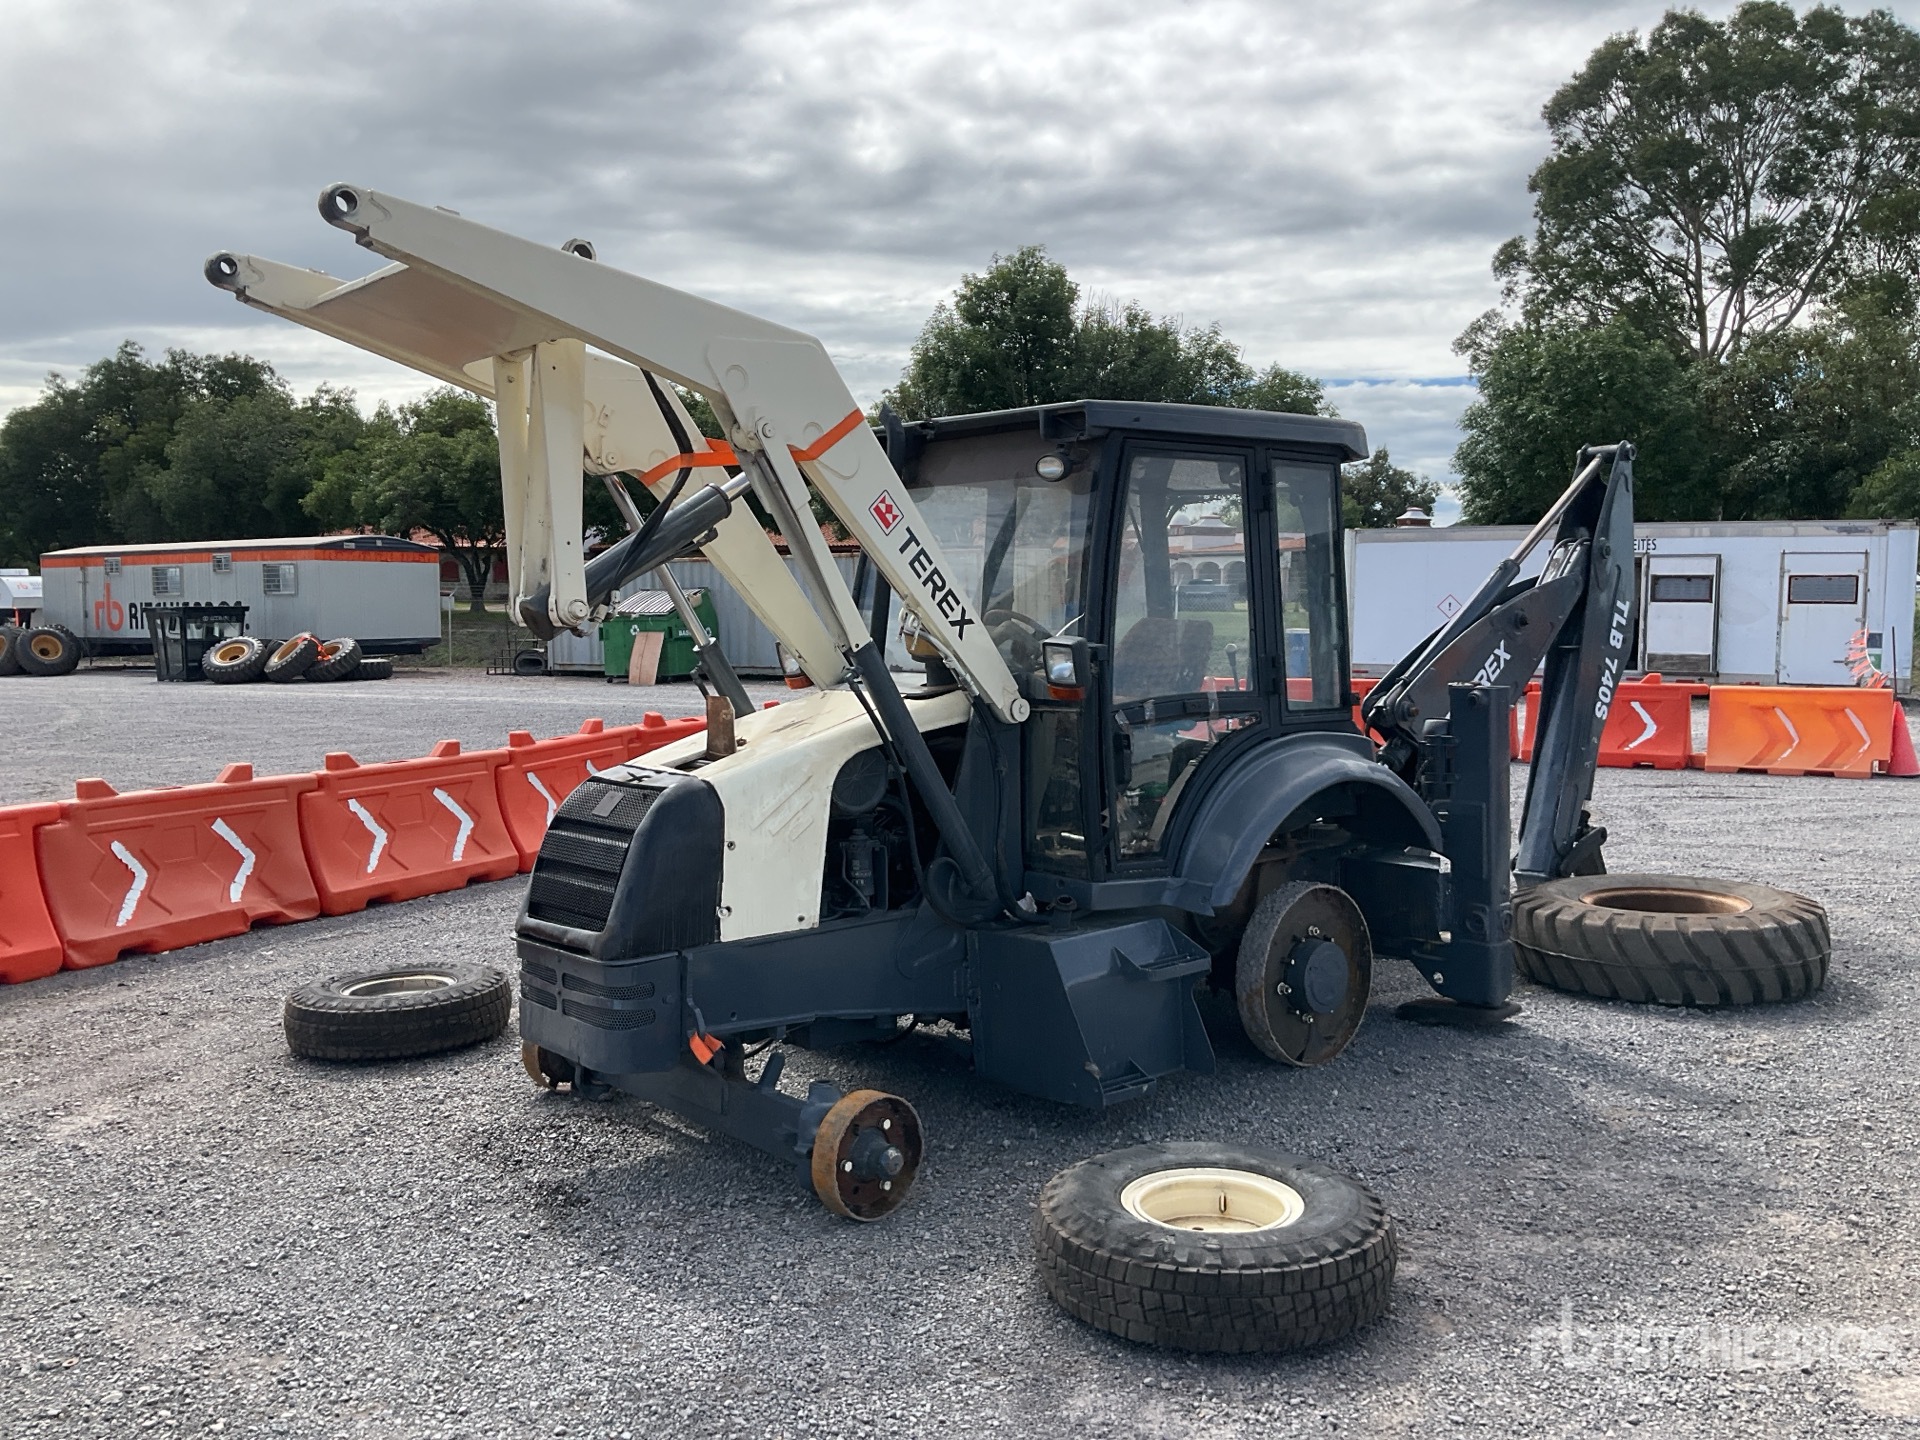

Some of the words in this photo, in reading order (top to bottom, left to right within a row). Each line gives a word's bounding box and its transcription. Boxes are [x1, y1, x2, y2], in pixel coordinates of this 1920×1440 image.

[1634, 538, 1657, 551] EITES
[94, 582, 124, 631] rb
[899, 526, 975, 641] TEREX
[1609, 600, 1630, 649] TLB
[1474, 639, 1511, 687] REX
[1595, 657, 1618, 720] 740S
